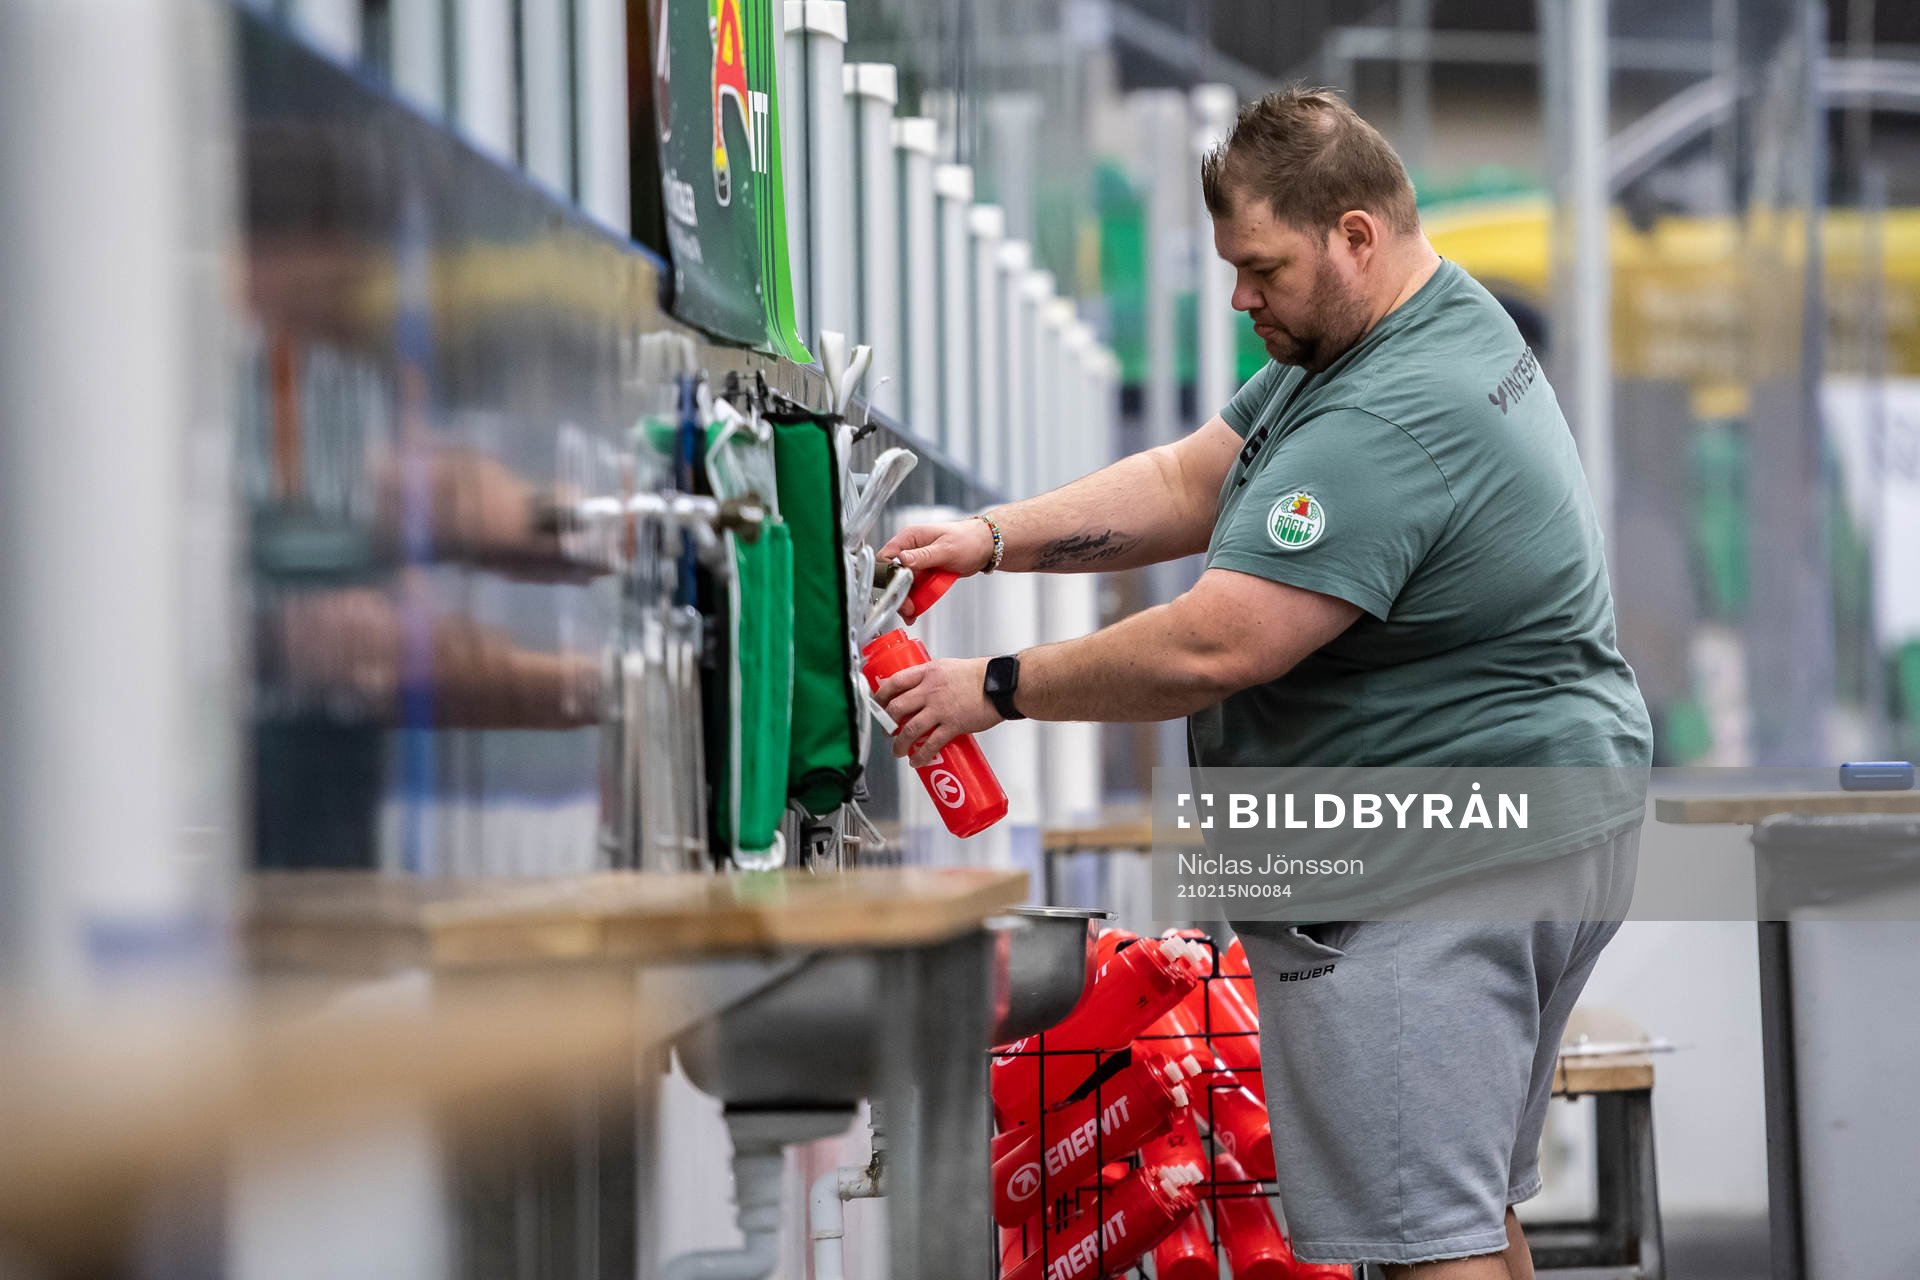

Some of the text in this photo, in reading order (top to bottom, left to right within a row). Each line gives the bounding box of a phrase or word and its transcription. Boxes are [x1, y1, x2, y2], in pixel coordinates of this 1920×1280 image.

[1502, 347, 1537, 404] INTER
[1274, 514, 1315, 544] RÖGLE
[1044, 1095, 1130, 1177] ENERVIT
